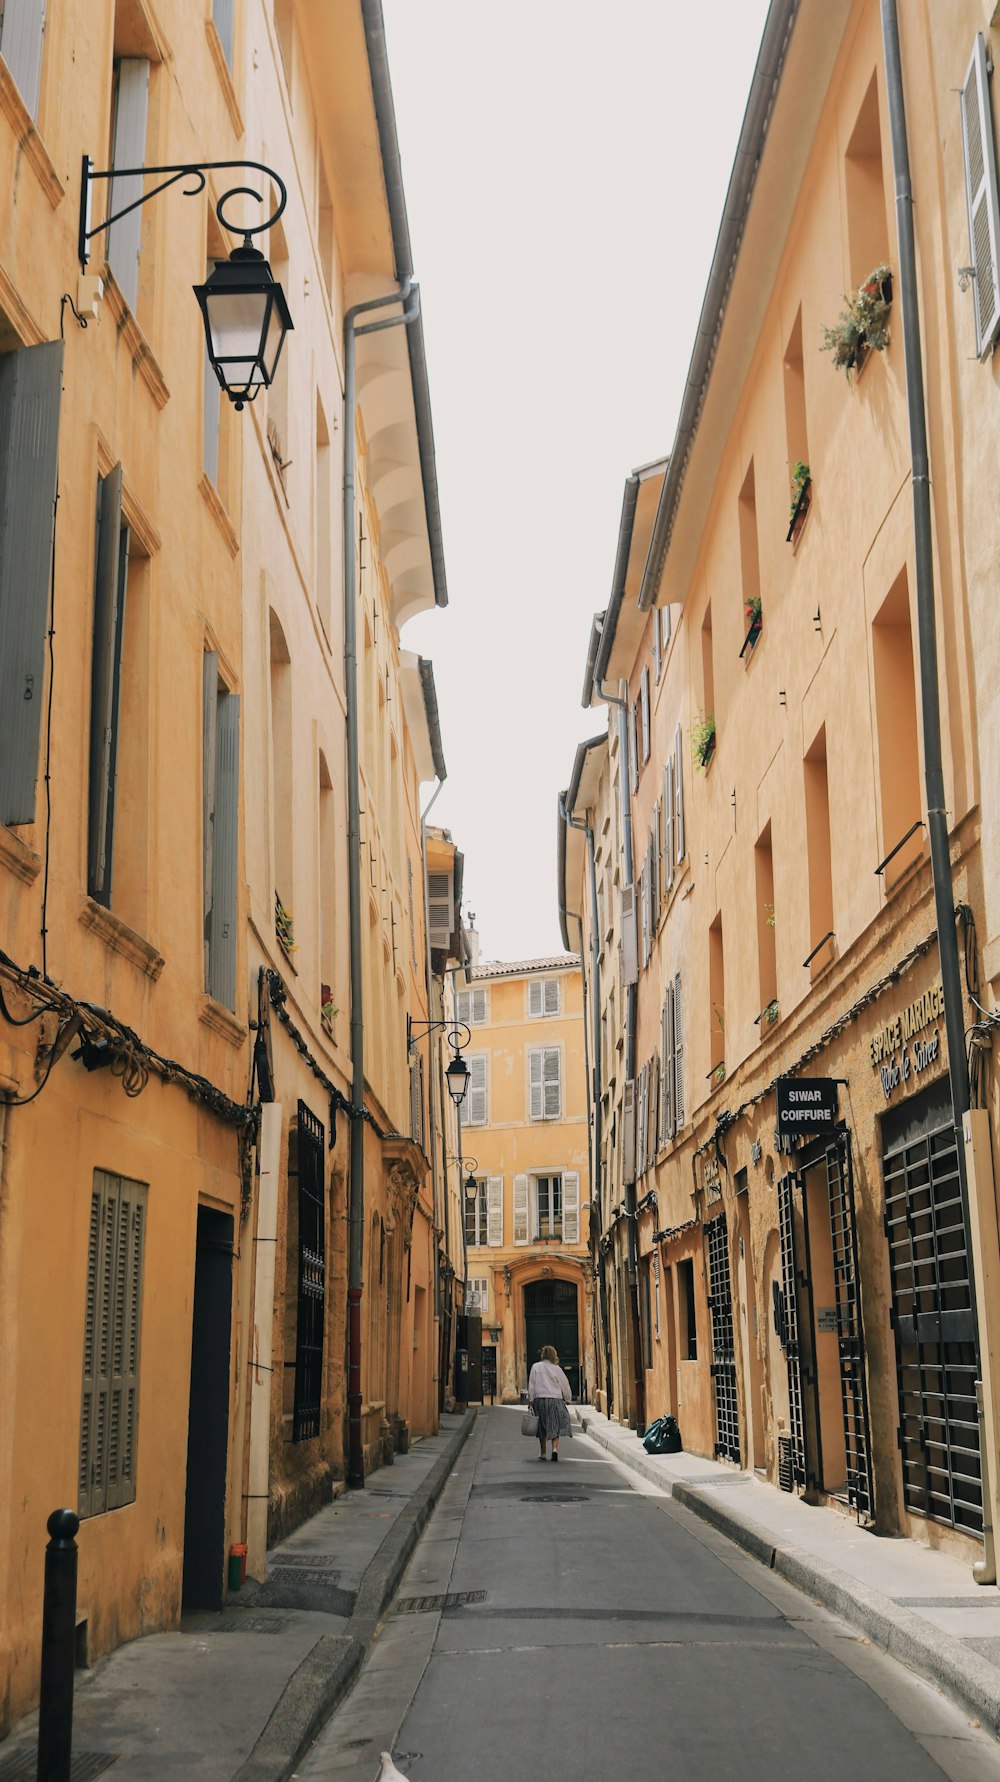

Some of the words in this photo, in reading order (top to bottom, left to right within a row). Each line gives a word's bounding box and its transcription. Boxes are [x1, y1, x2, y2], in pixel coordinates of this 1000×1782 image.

[870, 1015, 900, 1067] ESPACE
[901, 985, 944, 1041] MARIAGE
[901, 1046, 910, 1080] de
[788, 1090, 822, 1102] SIWAR
[781, 1109, 831, 1121] COIFFURE
